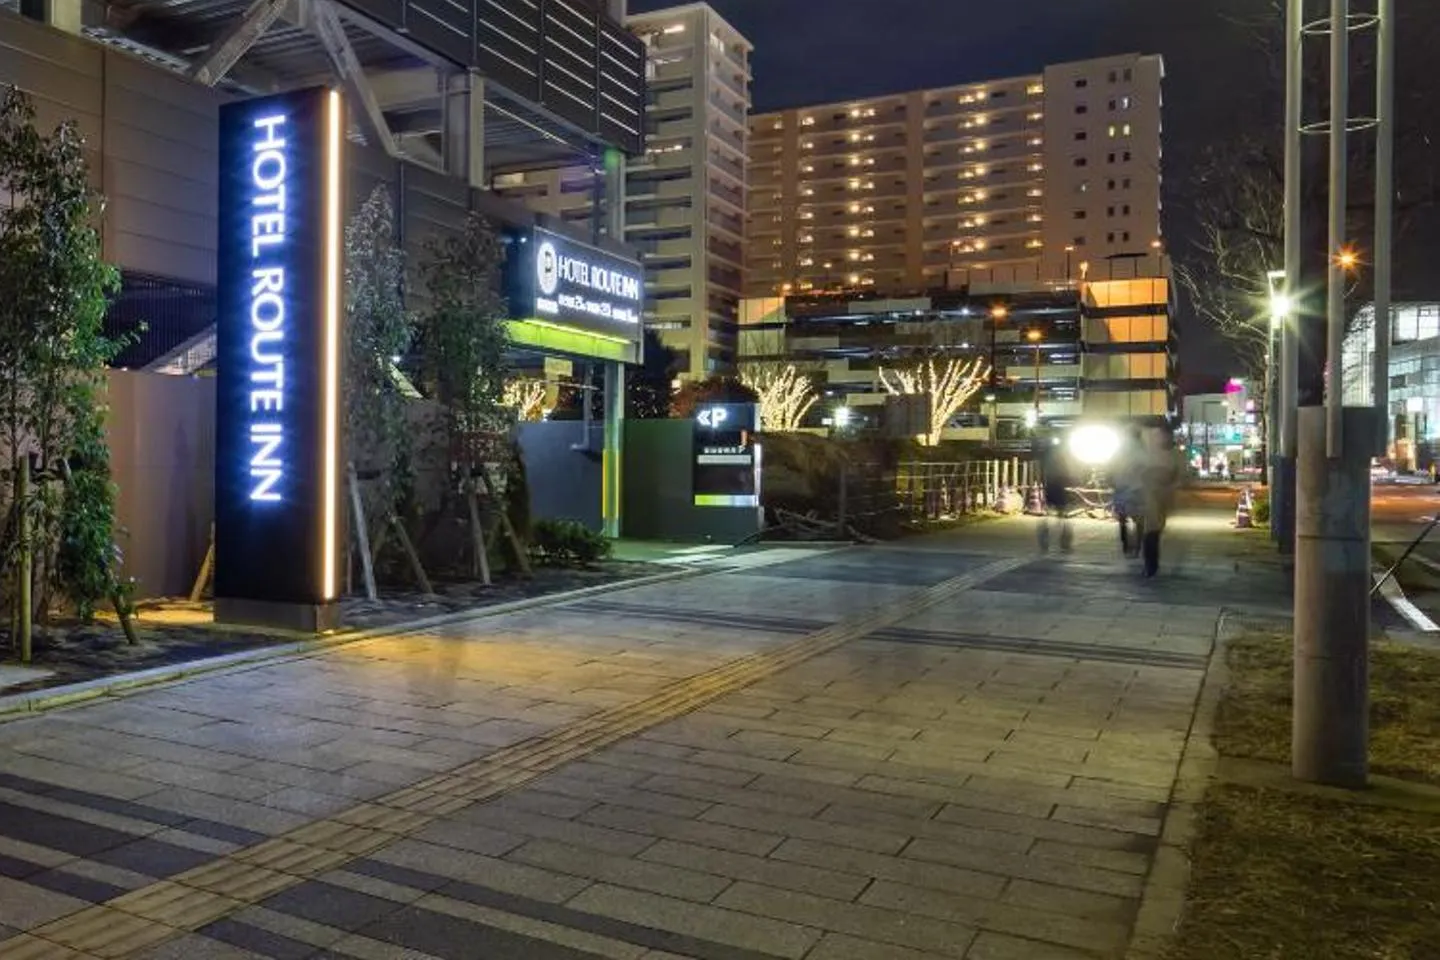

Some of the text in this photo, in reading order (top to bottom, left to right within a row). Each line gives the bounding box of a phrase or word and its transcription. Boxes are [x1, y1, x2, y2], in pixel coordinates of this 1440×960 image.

[558, 255, 590, 287] HOTEL
[591, 266, 623, 297] ROUTE
[250, 115, 286, 502] HOTEL ROUTE INN
[711, 407, 728, 429] P
